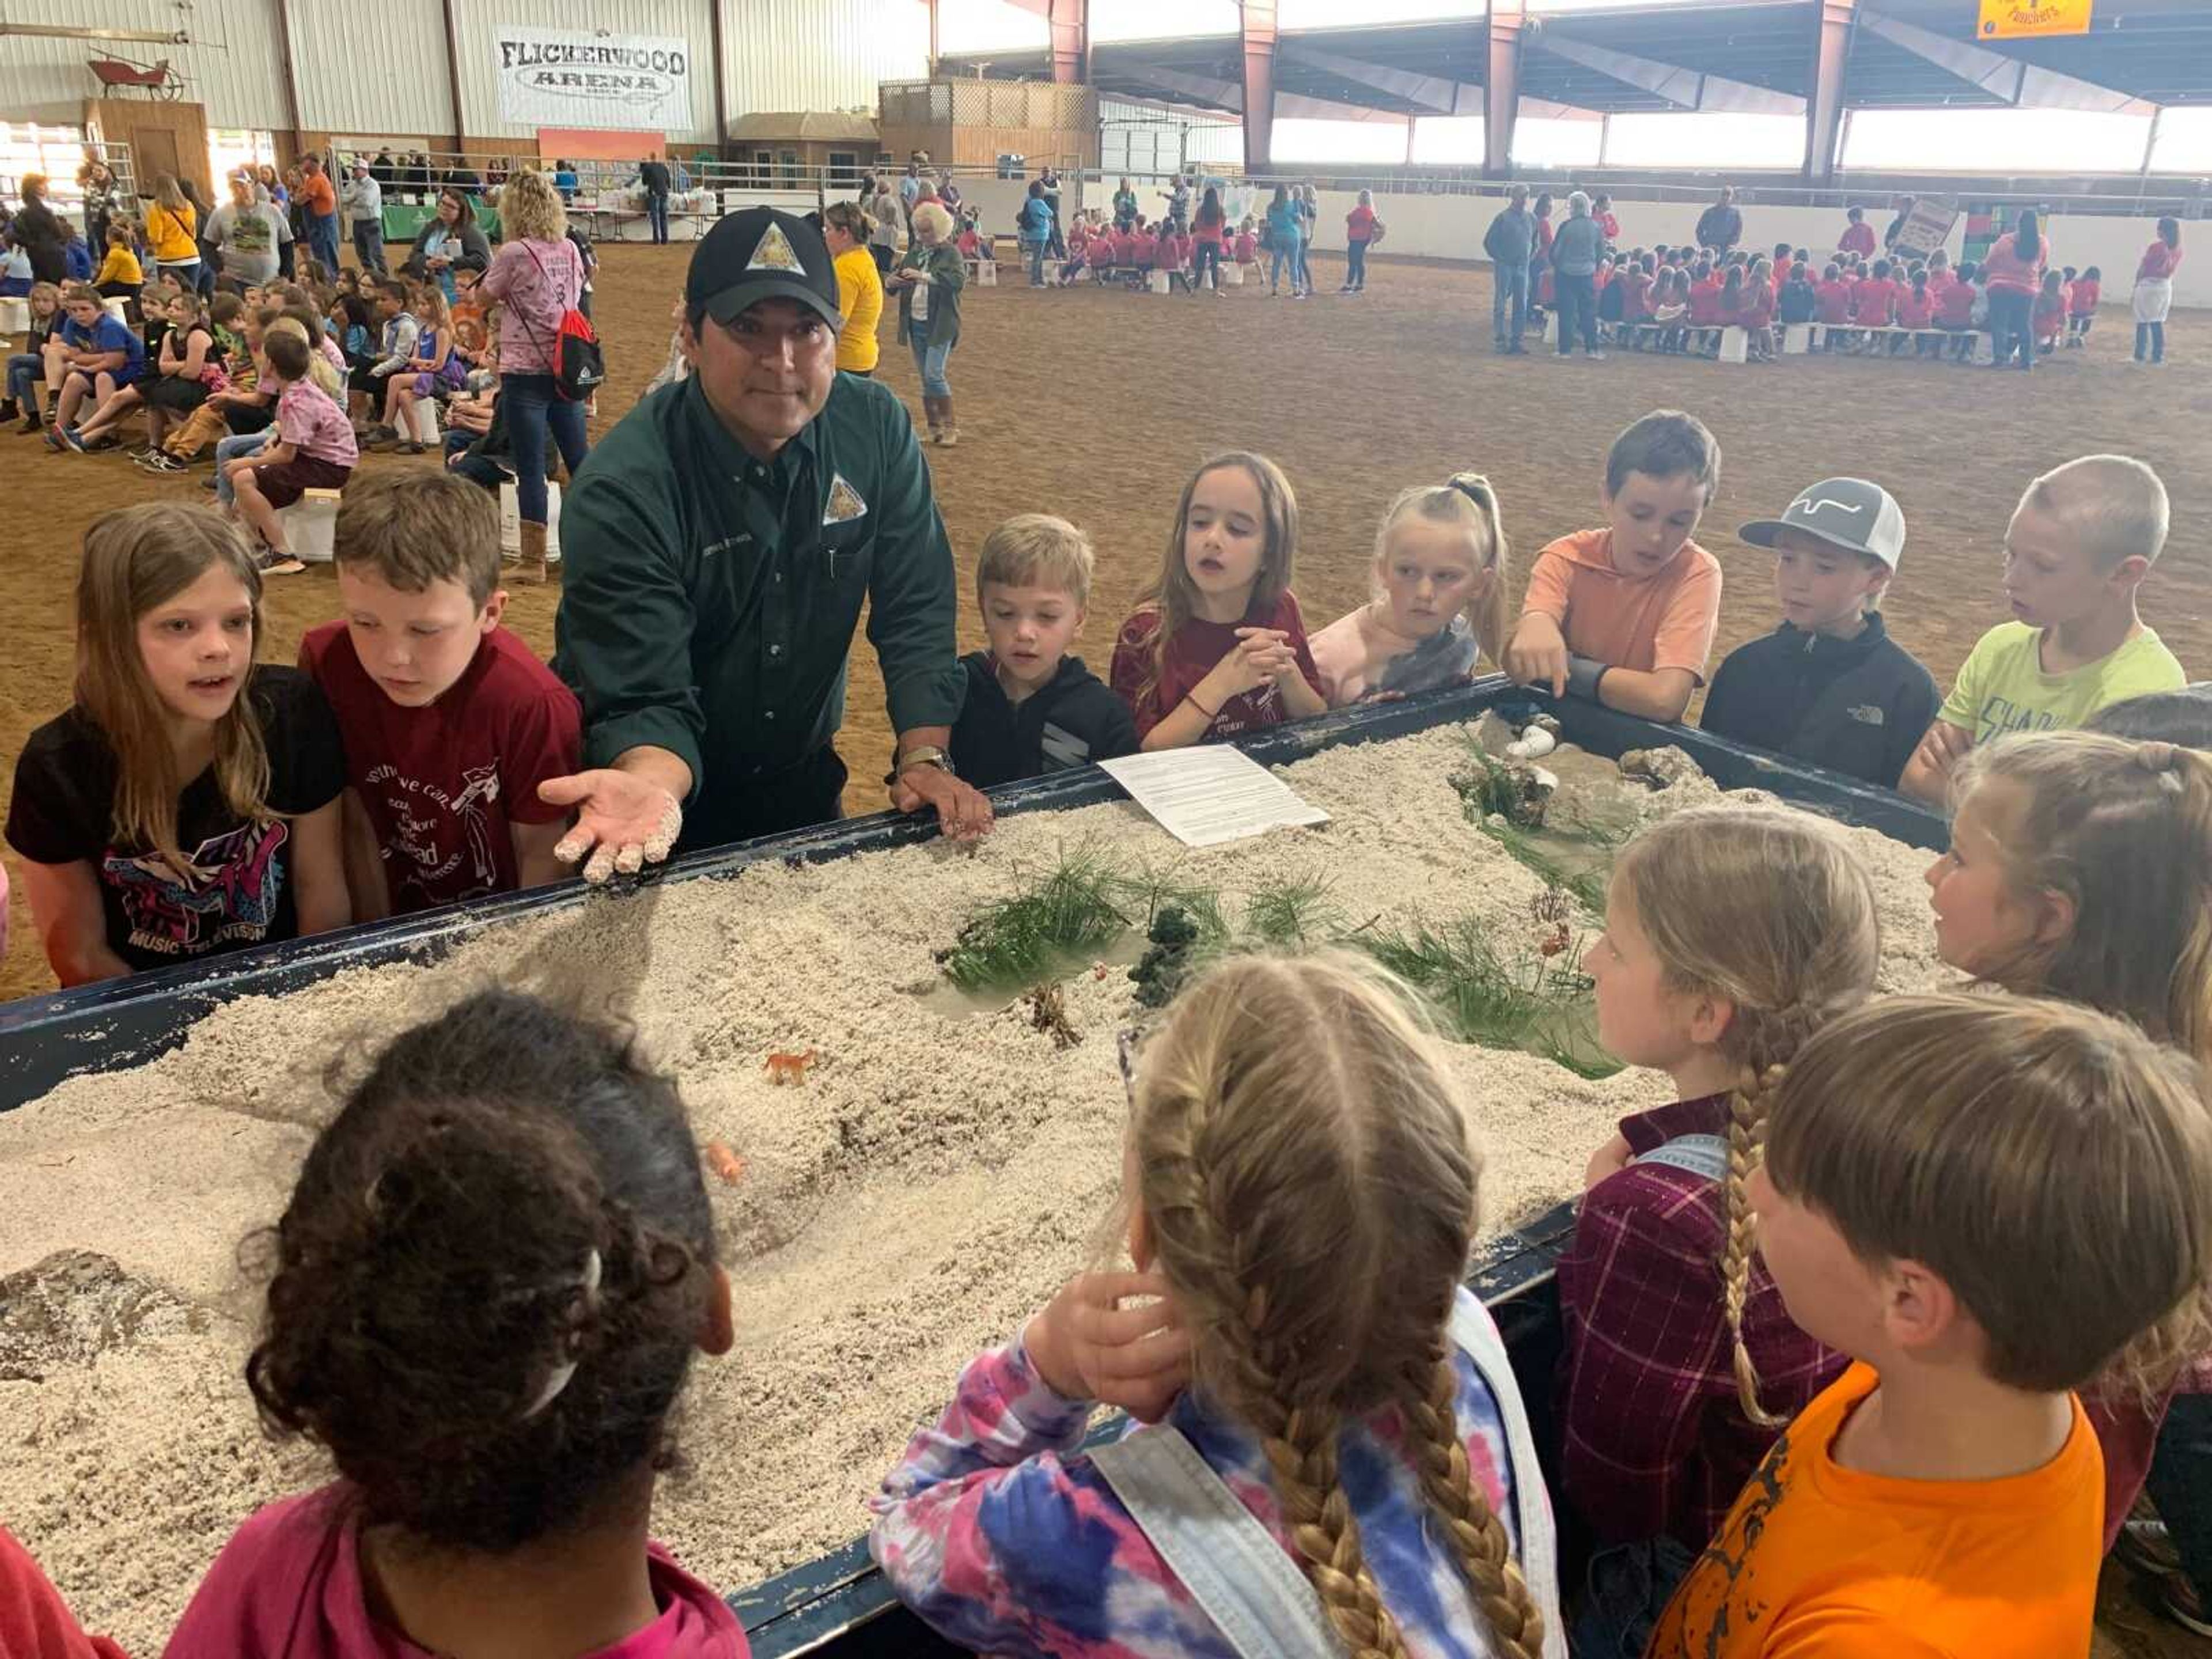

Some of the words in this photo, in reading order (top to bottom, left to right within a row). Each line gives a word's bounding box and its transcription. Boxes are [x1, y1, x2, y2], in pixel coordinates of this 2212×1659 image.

[500, 41, 685, 75] FLICKERWOOD
[533, 72, 659, 89] ARENA
[127, 929, 180, 955] MUSIC
[184, 925, 267, 955] TELEVISON
